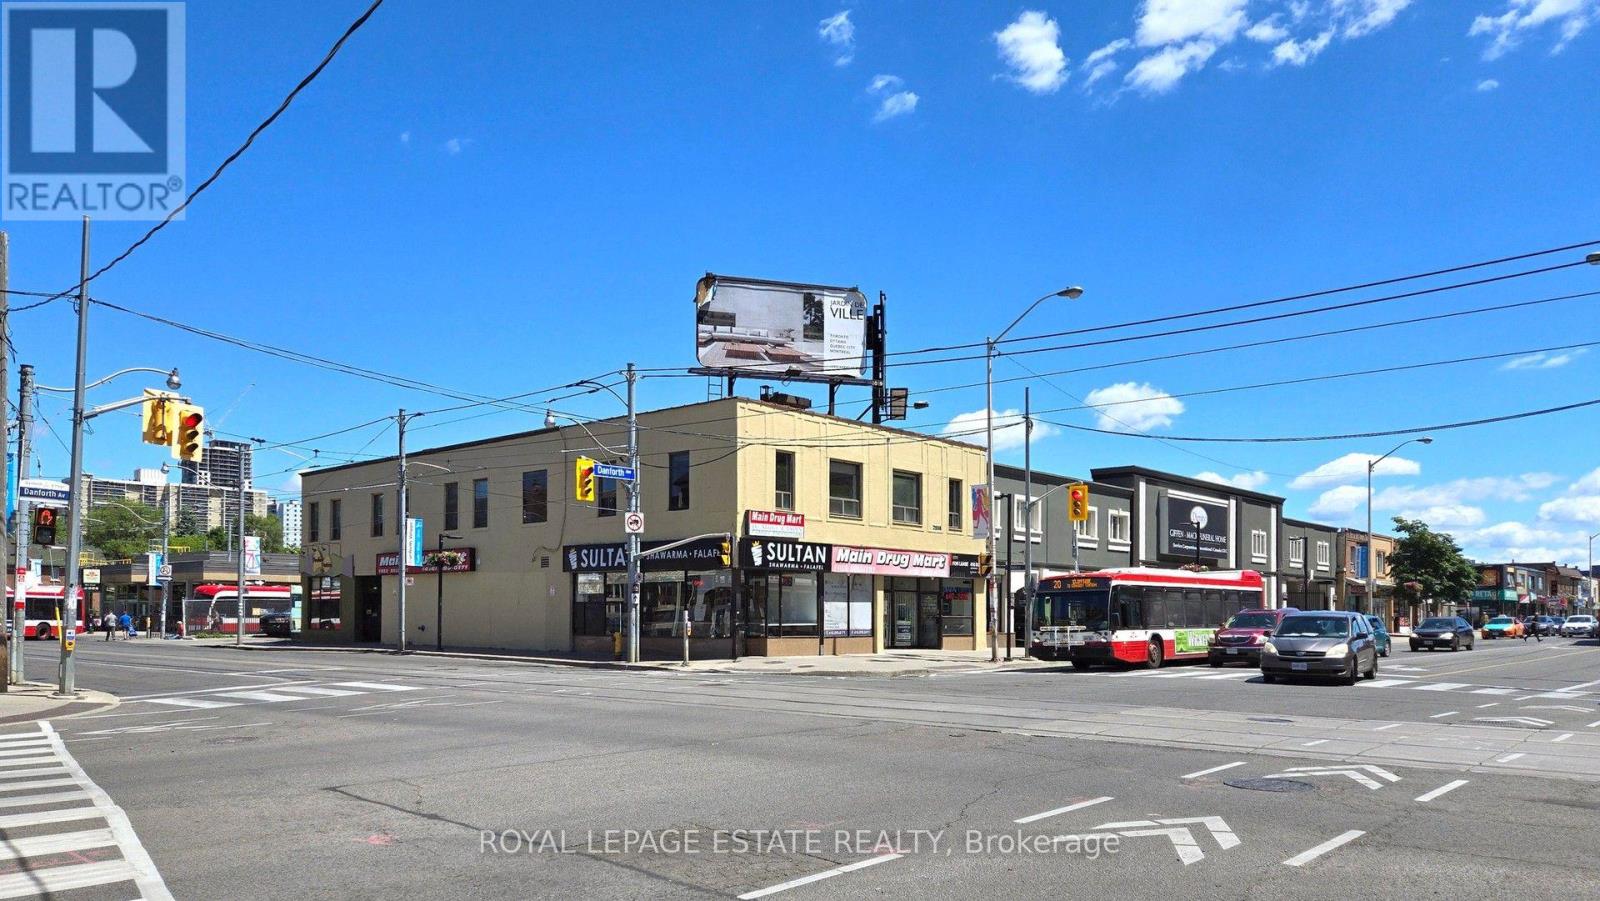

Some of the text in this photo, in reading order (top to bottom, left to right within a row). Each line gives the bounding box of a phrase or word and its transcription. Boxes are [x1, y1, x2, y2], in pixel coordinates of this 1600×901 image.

[830, 307, 864, 321] VILLE
[597, 465, 625, 477] Danforth
[24, 487, 57, 498] Danforth
[751, 511, 802, 525] Main Drug Mart
[580, 545, 628, 568] SULTA
[766, 542, 827, 564] SULTAN
[835, 547, 946, 570] Main Drug Mart
[379, 554, 400, 567] Mai
[768, 562, 799, 570] SHAWARMA
[1053, 580, 1062, 589] 20
